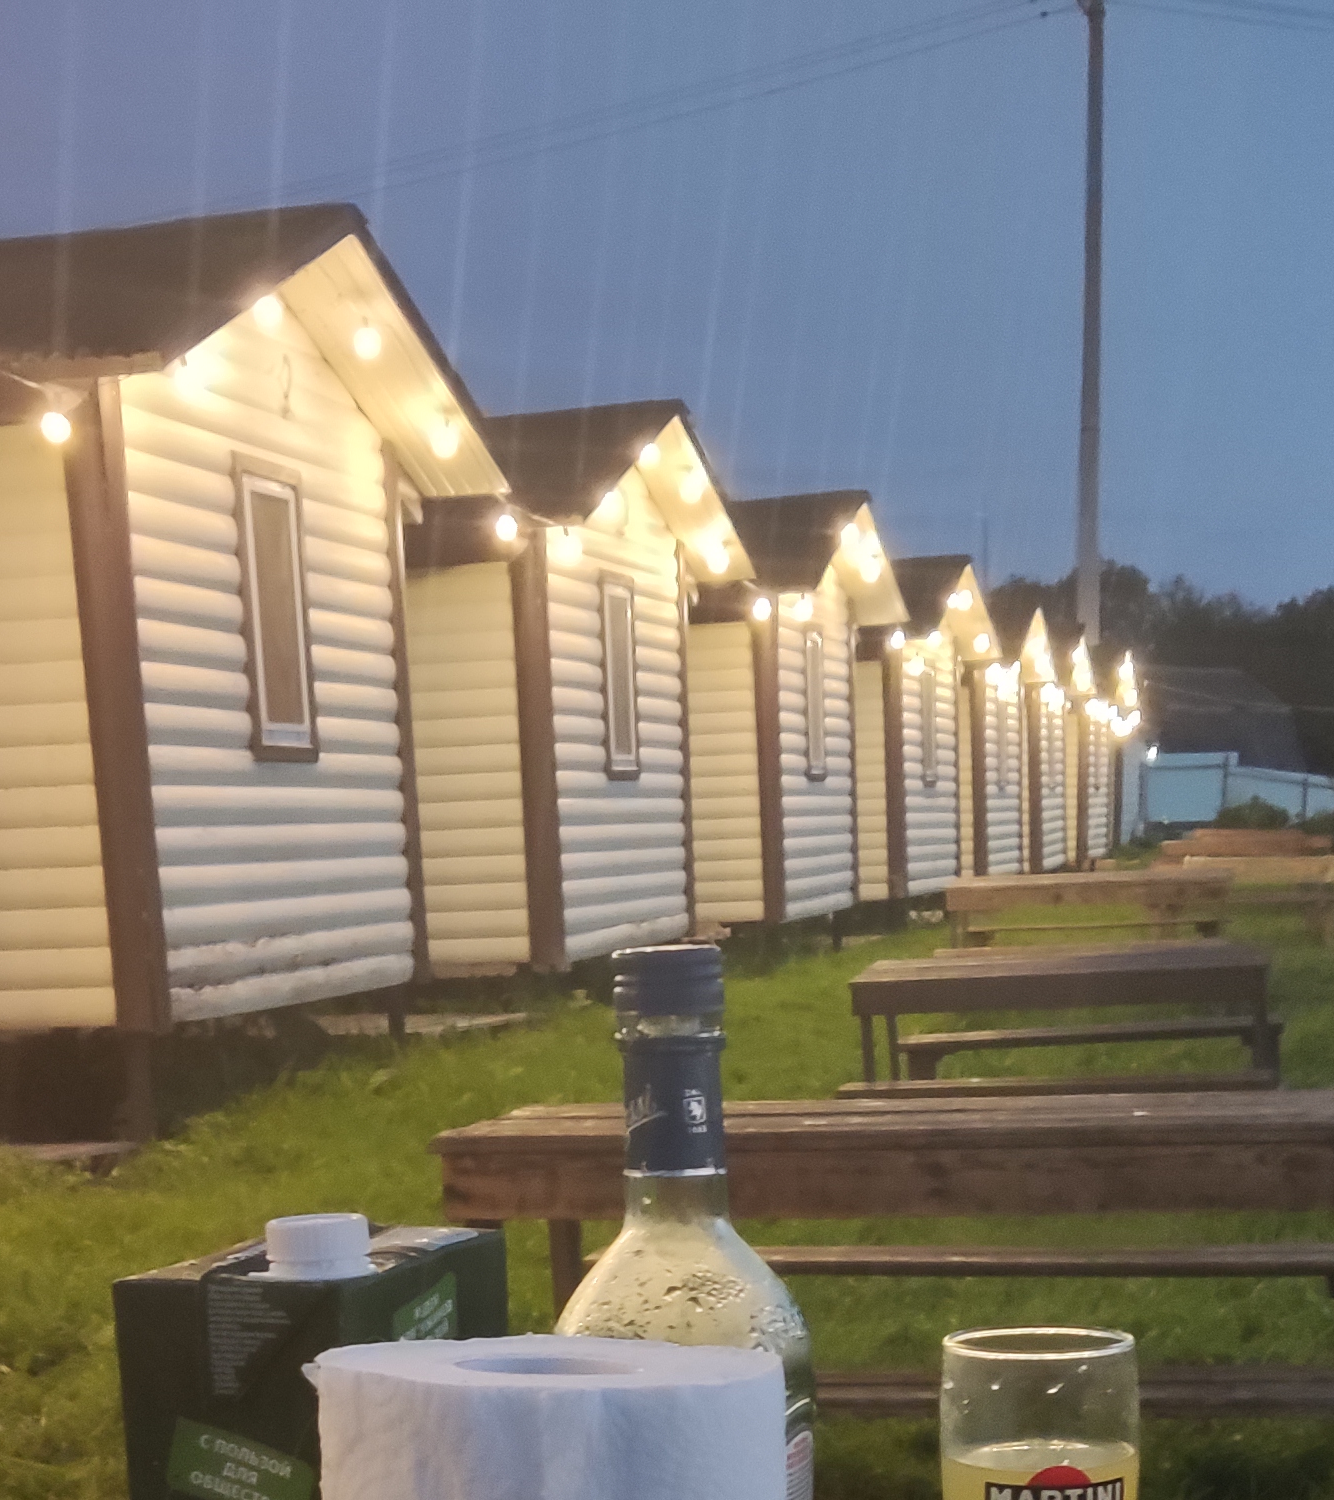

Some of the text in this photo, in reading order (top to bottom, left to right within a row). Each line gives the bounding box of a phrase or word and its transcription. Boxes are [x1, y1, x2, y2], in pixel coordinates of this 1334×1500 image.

[199, 1434, 292, 1479] С ПОЛЬЗОЙ
[222, 1462, 259, 1485] ДЛЯ
